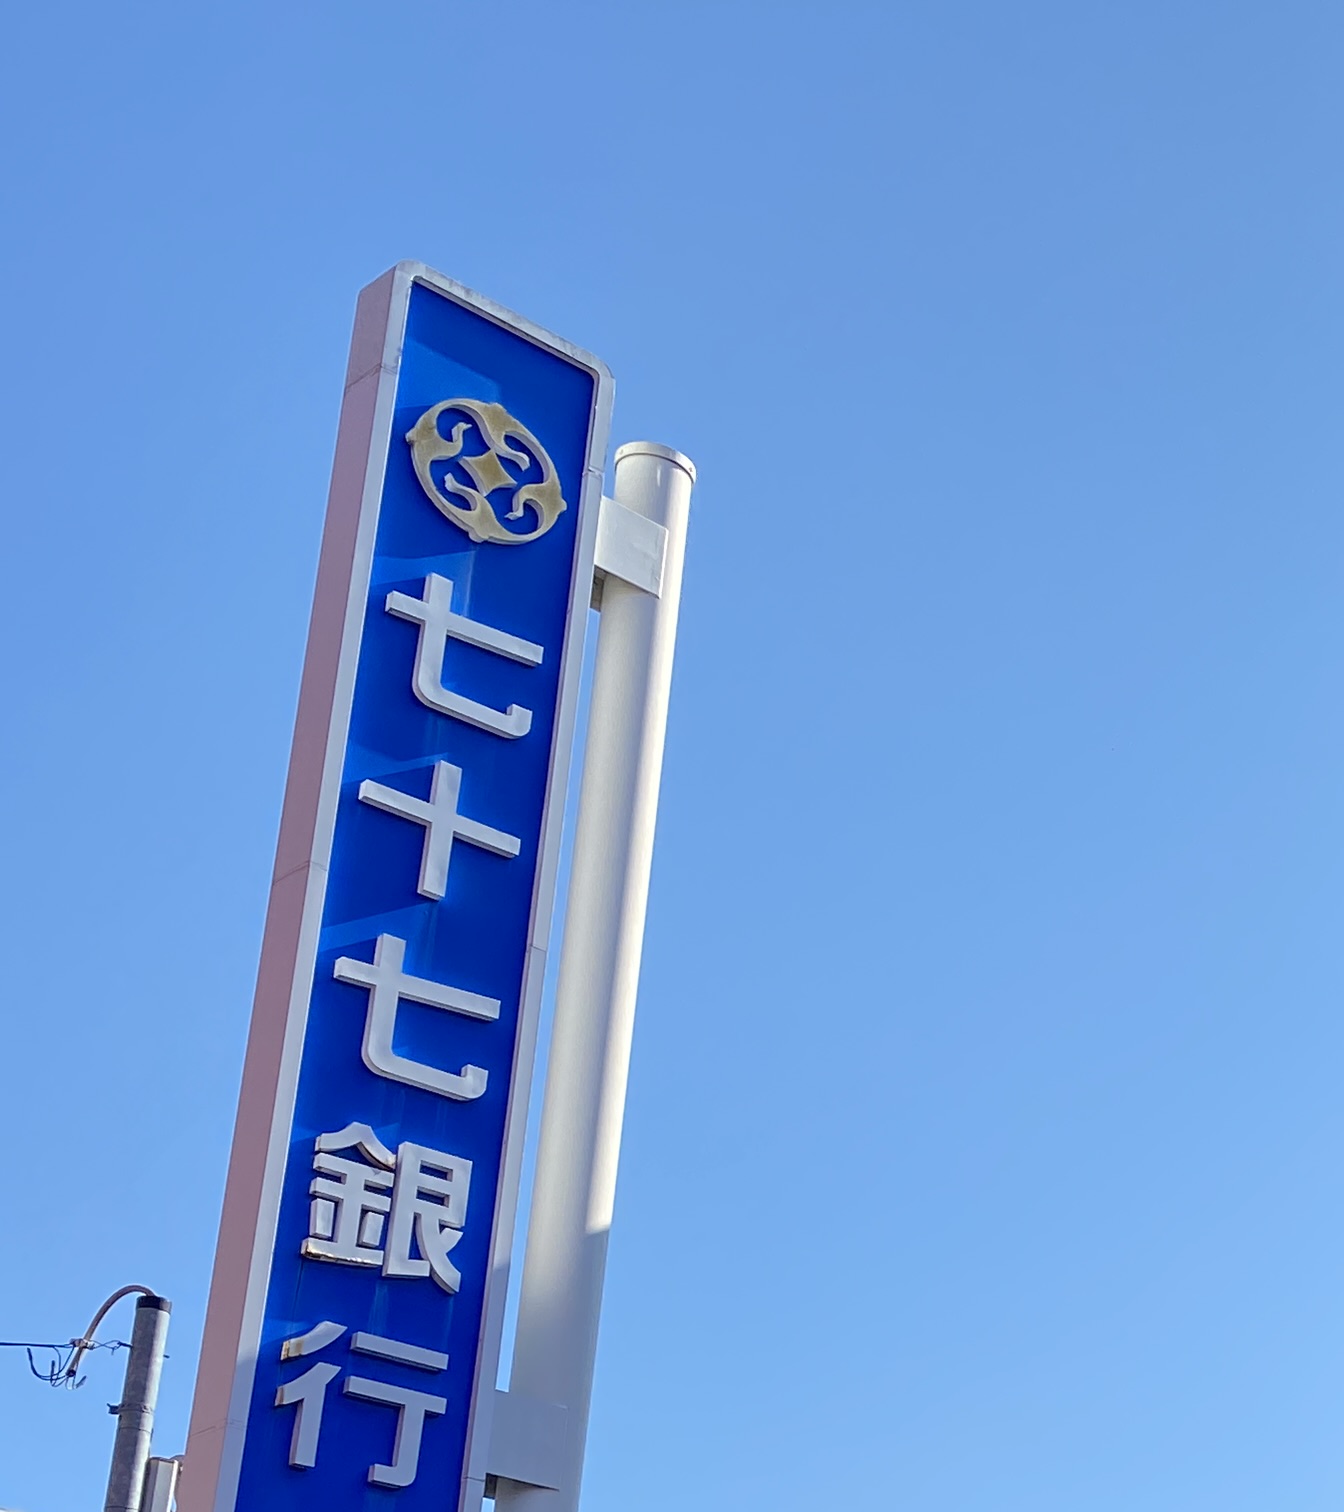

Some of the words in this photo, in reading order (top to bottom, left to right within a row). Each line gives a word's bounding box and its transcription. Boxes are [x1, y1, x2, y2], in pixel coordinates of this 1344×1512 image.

[274, 572, 545, 1488] 七十七銀行
